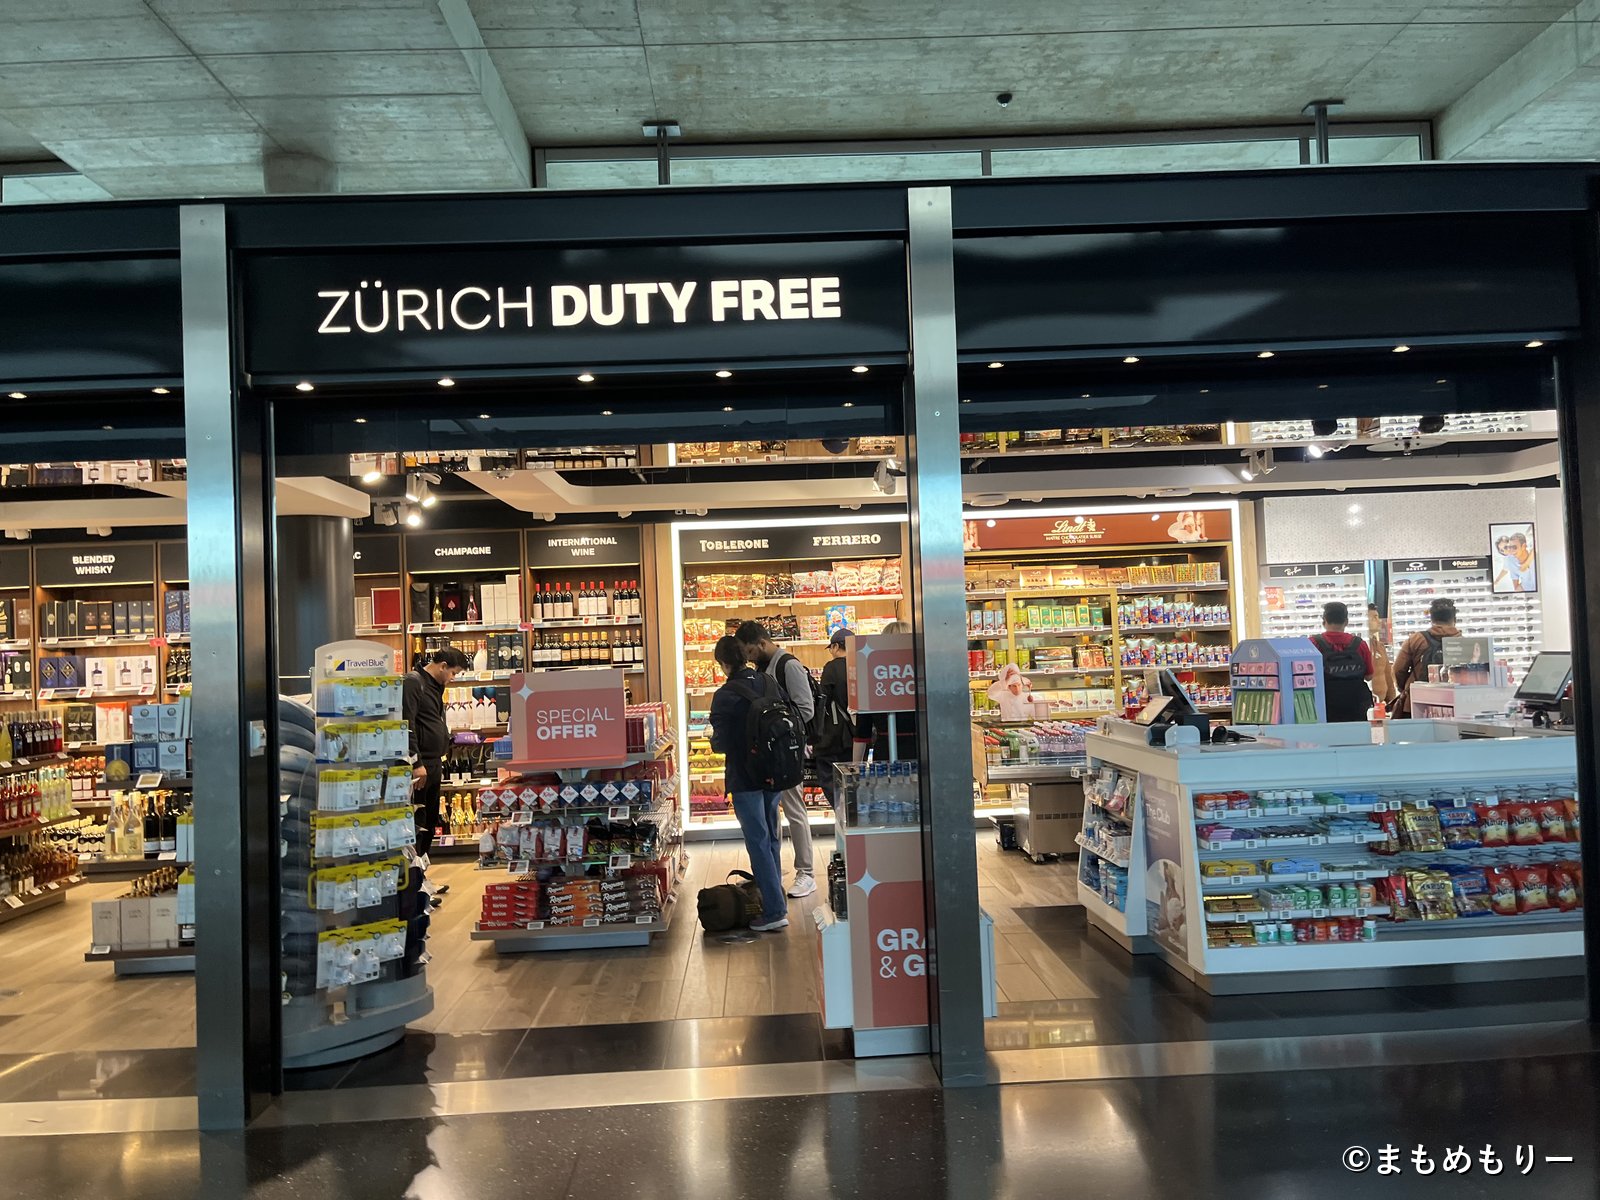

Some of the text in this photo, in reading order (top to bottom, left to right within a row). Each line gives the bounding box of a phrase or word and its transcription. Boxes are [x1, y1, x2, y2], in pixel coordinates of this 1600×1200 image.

[317, 277, 842, 334] ZÜRICH DUTY FREE
[1051, 519, 1088, 533] Lindt
[548, 536, 618, 547] INTERNATIONAL
[700, 539, 769, 553] TOBLERONE
[812, 534, 882, 546] FERRERO
[352, 551, 362, 560] C
[434, 546, 492, 557] CHAMPAGNE
[571, 547, 596, 557] WINE
[72, 554, 116, 565] BLENDED
[75, 565, 114, 575] WHISKY
[875, 681, 887, 697] &
[536, 707, 615, 724] SPECIAL
[536, 723, 598, 740] OFFER
[877, 928, 926, 952] GR
[879, 955, 898, 979] &
